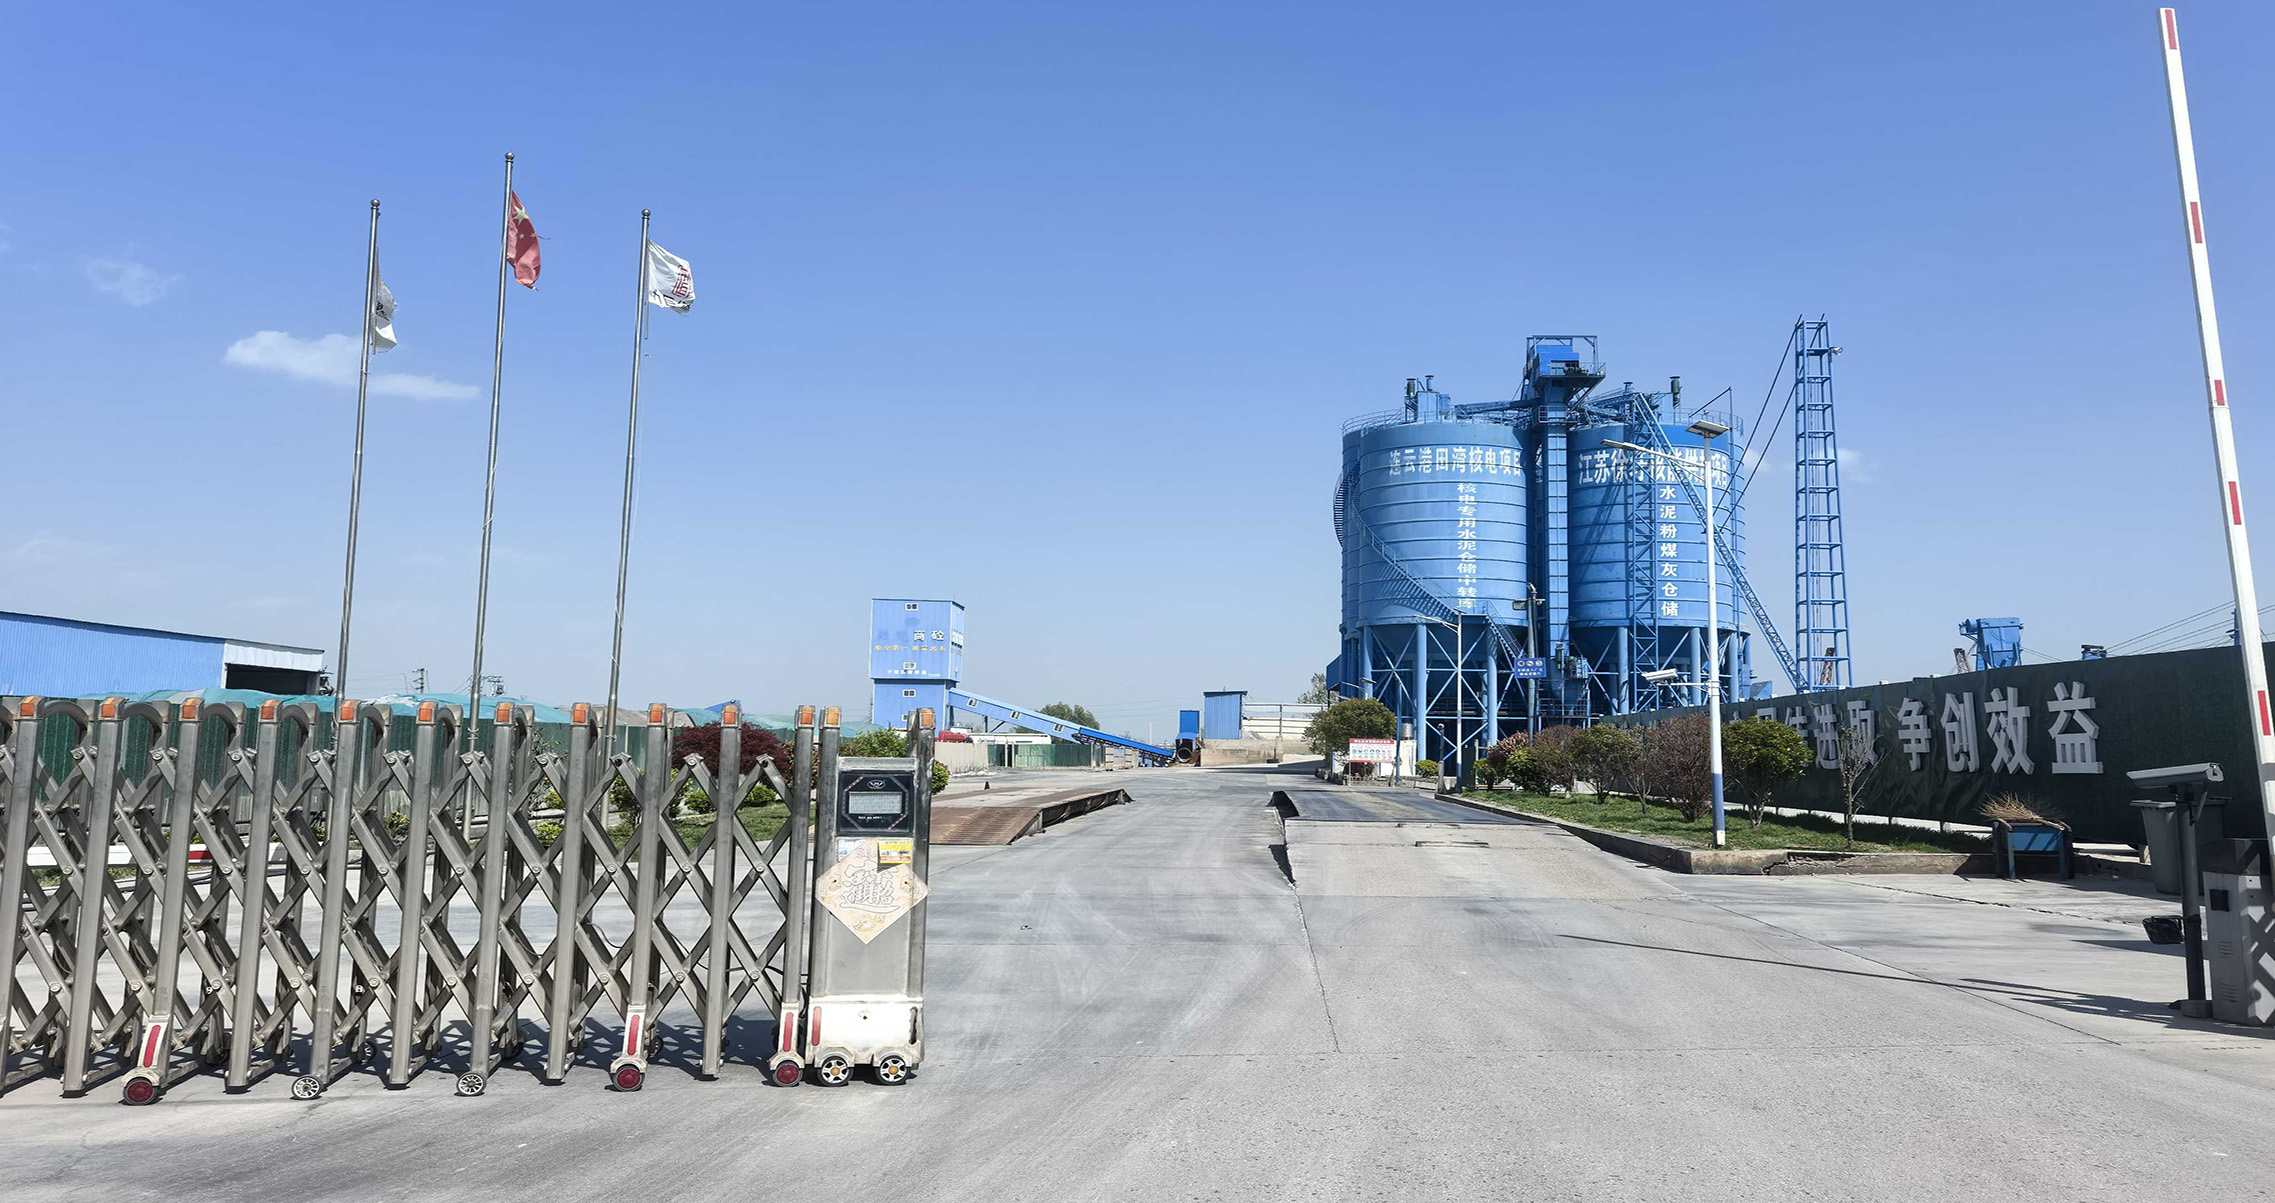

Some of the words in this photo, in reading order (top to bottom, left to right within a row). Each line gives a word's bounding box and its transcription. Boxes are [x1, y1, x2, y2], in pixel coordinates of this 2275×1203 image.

[1457, 482, 1477, 609] 核电专用水泥仓储中转库
[1659, 485, 1679, 617] 水泥粉煤灰仓储
